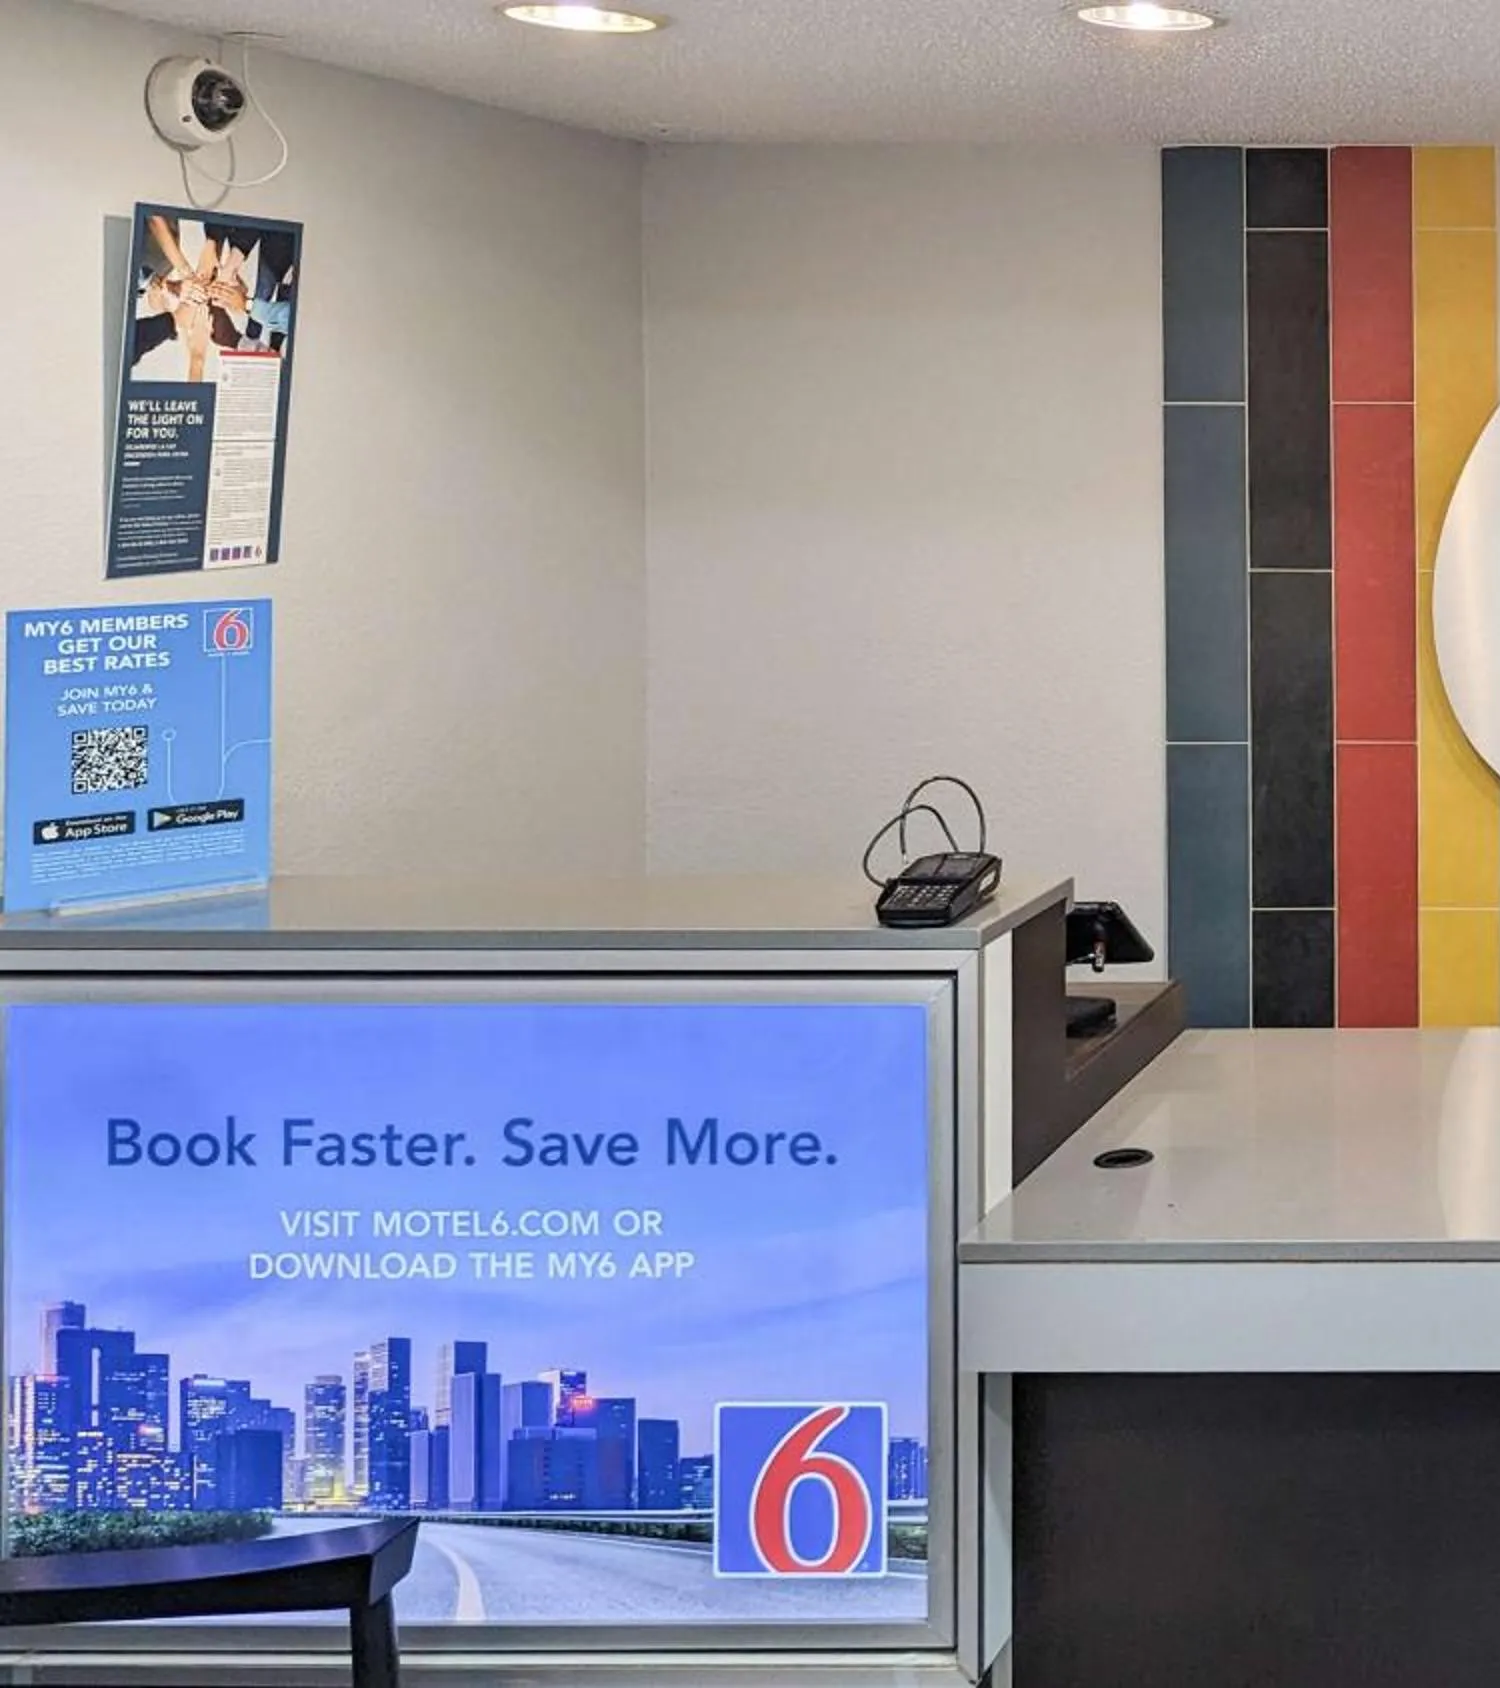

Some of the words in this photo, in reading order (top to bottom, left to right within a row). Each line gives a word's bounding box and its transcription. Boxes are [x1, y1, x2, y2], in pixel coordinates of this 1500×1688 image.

[127, 400, 161, 412] WE'LL
[164, 401, 198, 412] LEAVE
[127, 414, 149, 426] THE
[152, 414, 183, 426] LIGHT
[185, 413, 204, 425] ON
[126, 427, 149, 439] FOR
[153, 427, 180, 439] YOU.
[24, 620, 73, 638] MY6
[80, 613, 189, 634] MEMBERS
[213, 607, 249, 651] 6
[58, 637, 102, 655] GET
[109, 634, 157, 651] OUR
[43, 658, 97, 675] BEST
[104, 651, 171, 671] RATES
[60, 687, 99, 701] JOIN
[103, 684, 137, 698] MY6
[57, 702, 97, 717] SAVE
[103, 698, 157, 713] TODAY
[175, 811, 214, 826] Google
[216, 809, 239, 822] Play
[64, 824, 92, 840] App
[93, 821, 128, 835] Store
[107, 1115, 257, 1167] Book
[283, 1118, 475, 1167] Faster.
[502, 1117, 639, 1167] Save
[667, 1117, 837, 1166] More.
[280, 1210, 361, 1238] VISIT
[373, 1210, 599, 1238] MOTEL6.COM
[613, 1209, 663, 1237] OR
[249, 1252, 456, 1279] DOWNLOAD
[469, 1252, 533, 1279] THE
[548, 1251, 616, 1279] MY6
[629, 1252, 695, 1278] APP
[750, 1404, 873, 1577] 6
